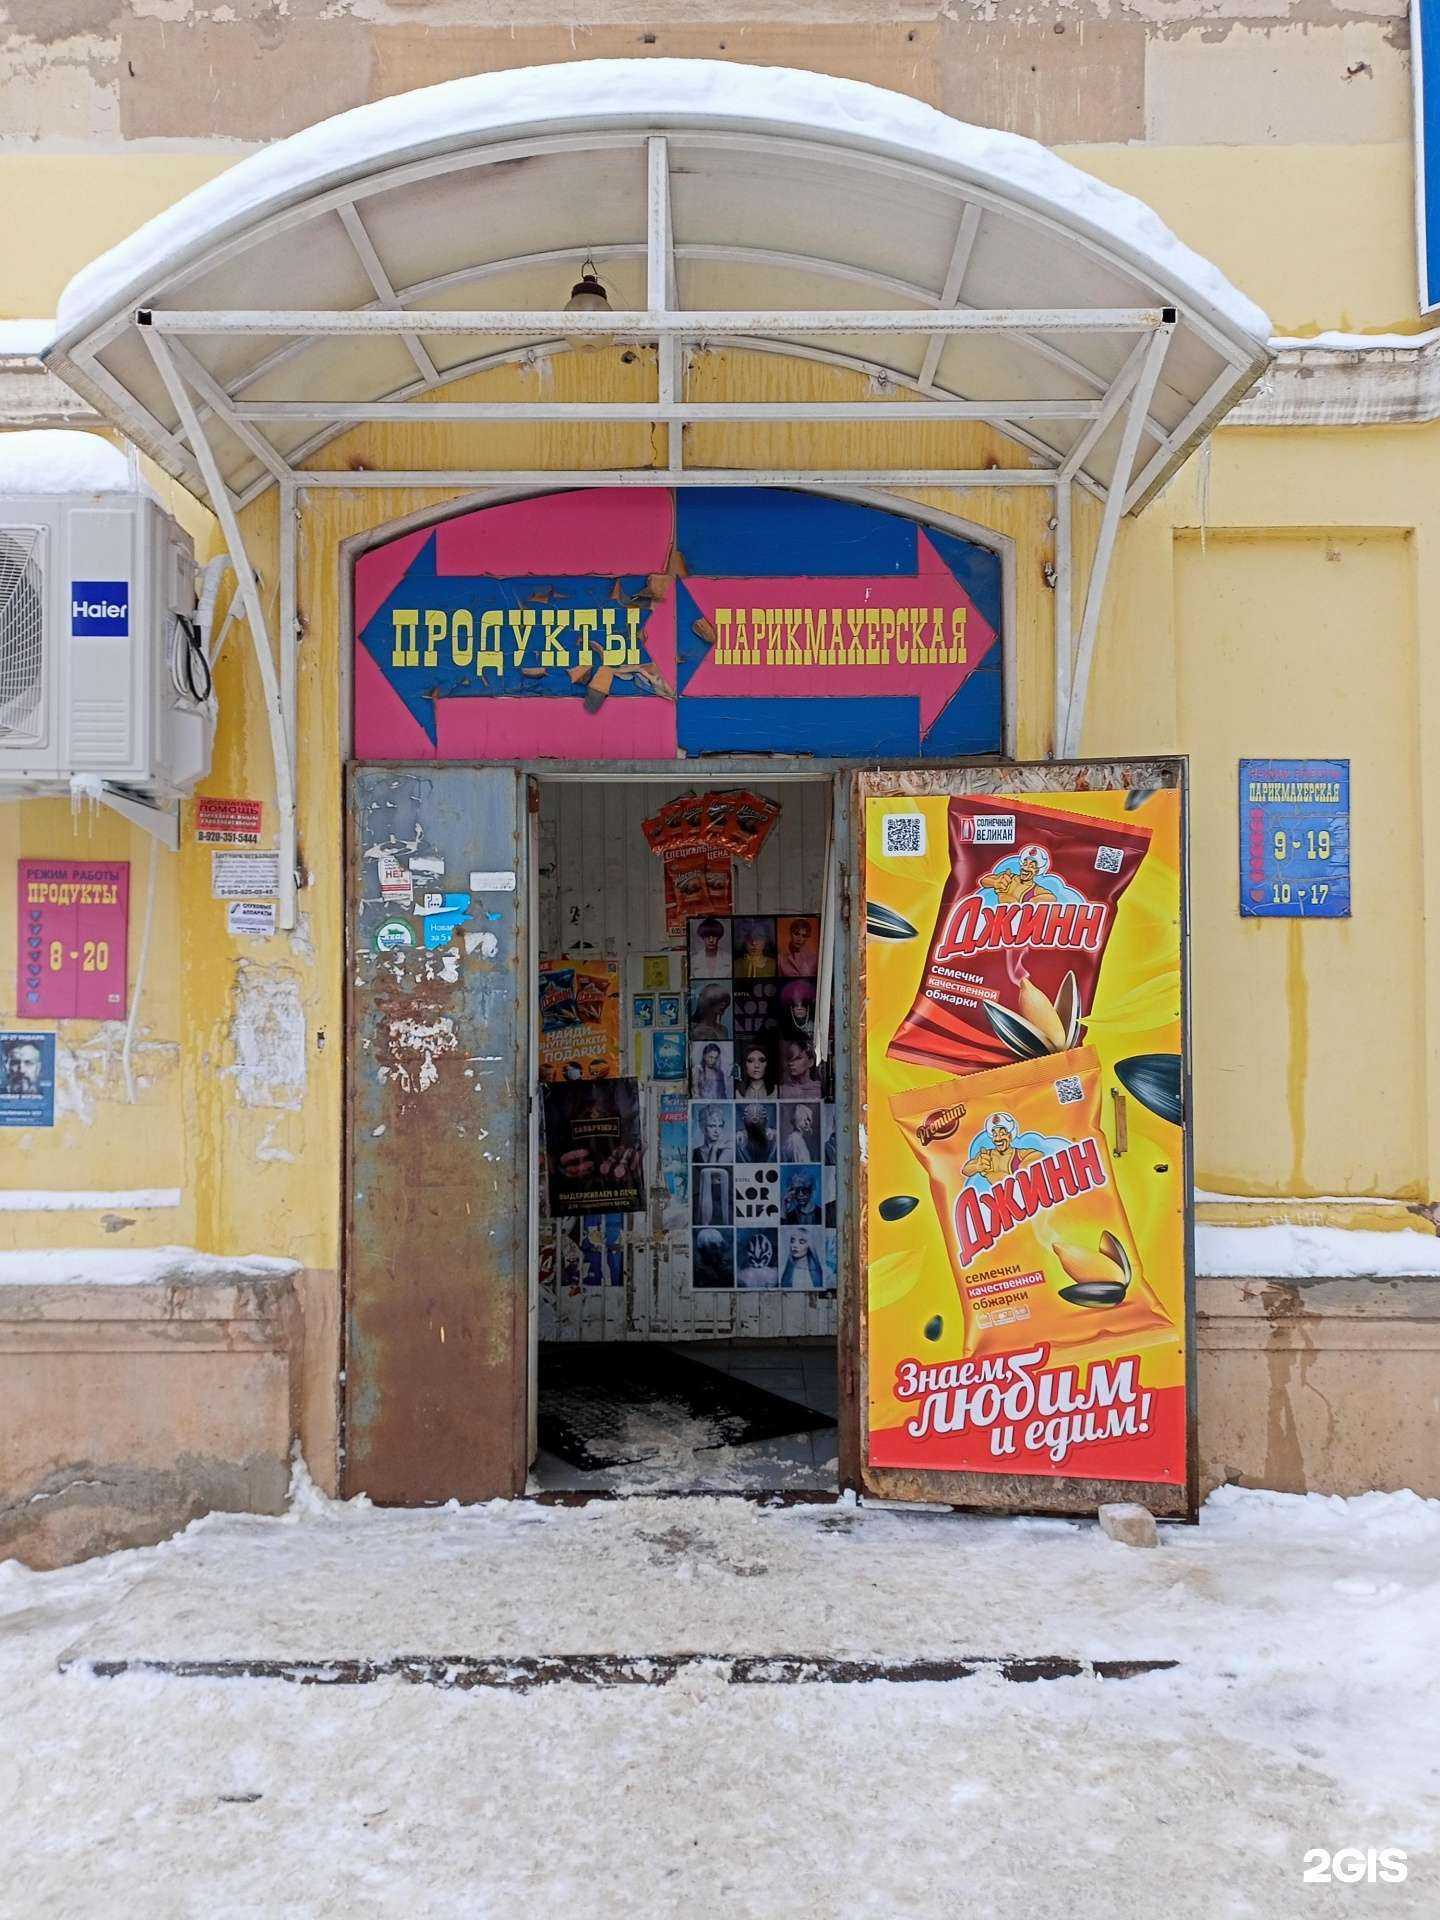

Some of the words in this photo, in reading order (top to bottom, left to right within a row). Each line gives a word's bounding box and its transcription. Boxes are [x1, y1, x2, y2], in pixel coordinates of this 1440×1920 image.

[72, 601, 128, 618] Haier
[392, 608, 641, 676] ПРОДУКТЫ
[714, 607, 968, 665] ПАРИКМАХЕРСКАЯ
[1249, 782, 1340, 803] ПАРИКМАХЕРСКАЯ
[199, 805, 258, 815] ПОМОЩЬ
[976, 817, 1013, 828] СОЛНЕЧНЫЙ
[976, 829, 1013, 841] ВЕЛИКАН
[1274, 831, 1286, 860] 9
[1307, 830, 1331, 860] 19
[26, 869, 67, 880] РЕЖИМ
[72, 870, 120, 881] РАБОТЫ
[386, 870, 405, 878] НЕТ
[27, 883, 118, 906] ПРОДУКТЫ
[1273, 883, 1291, 904] 10
[1311, 884, 1329, 905] 17
[50, 941, 62, 971] 8
[83, 941, 109, 971] 20
[931, 964, 985, 985] семечки
[925, 988, 979, 1009] обжарки
[928, 977, 998, 1001] качественной
[916, 1103, 967, 1146] Premium
[965, 1264, 1021, 1285] семечки
[969, 1274, 1043, 1297] качественной
[973, 1290, 1029, 1311] обжарки
[898, 1356, 1013, 1396] Знаем,
[908, 1348, 1136, 1437] любим
[990, 1426, 1016, 1456] и
[1025, 1393, 1151, 1462] едим!
